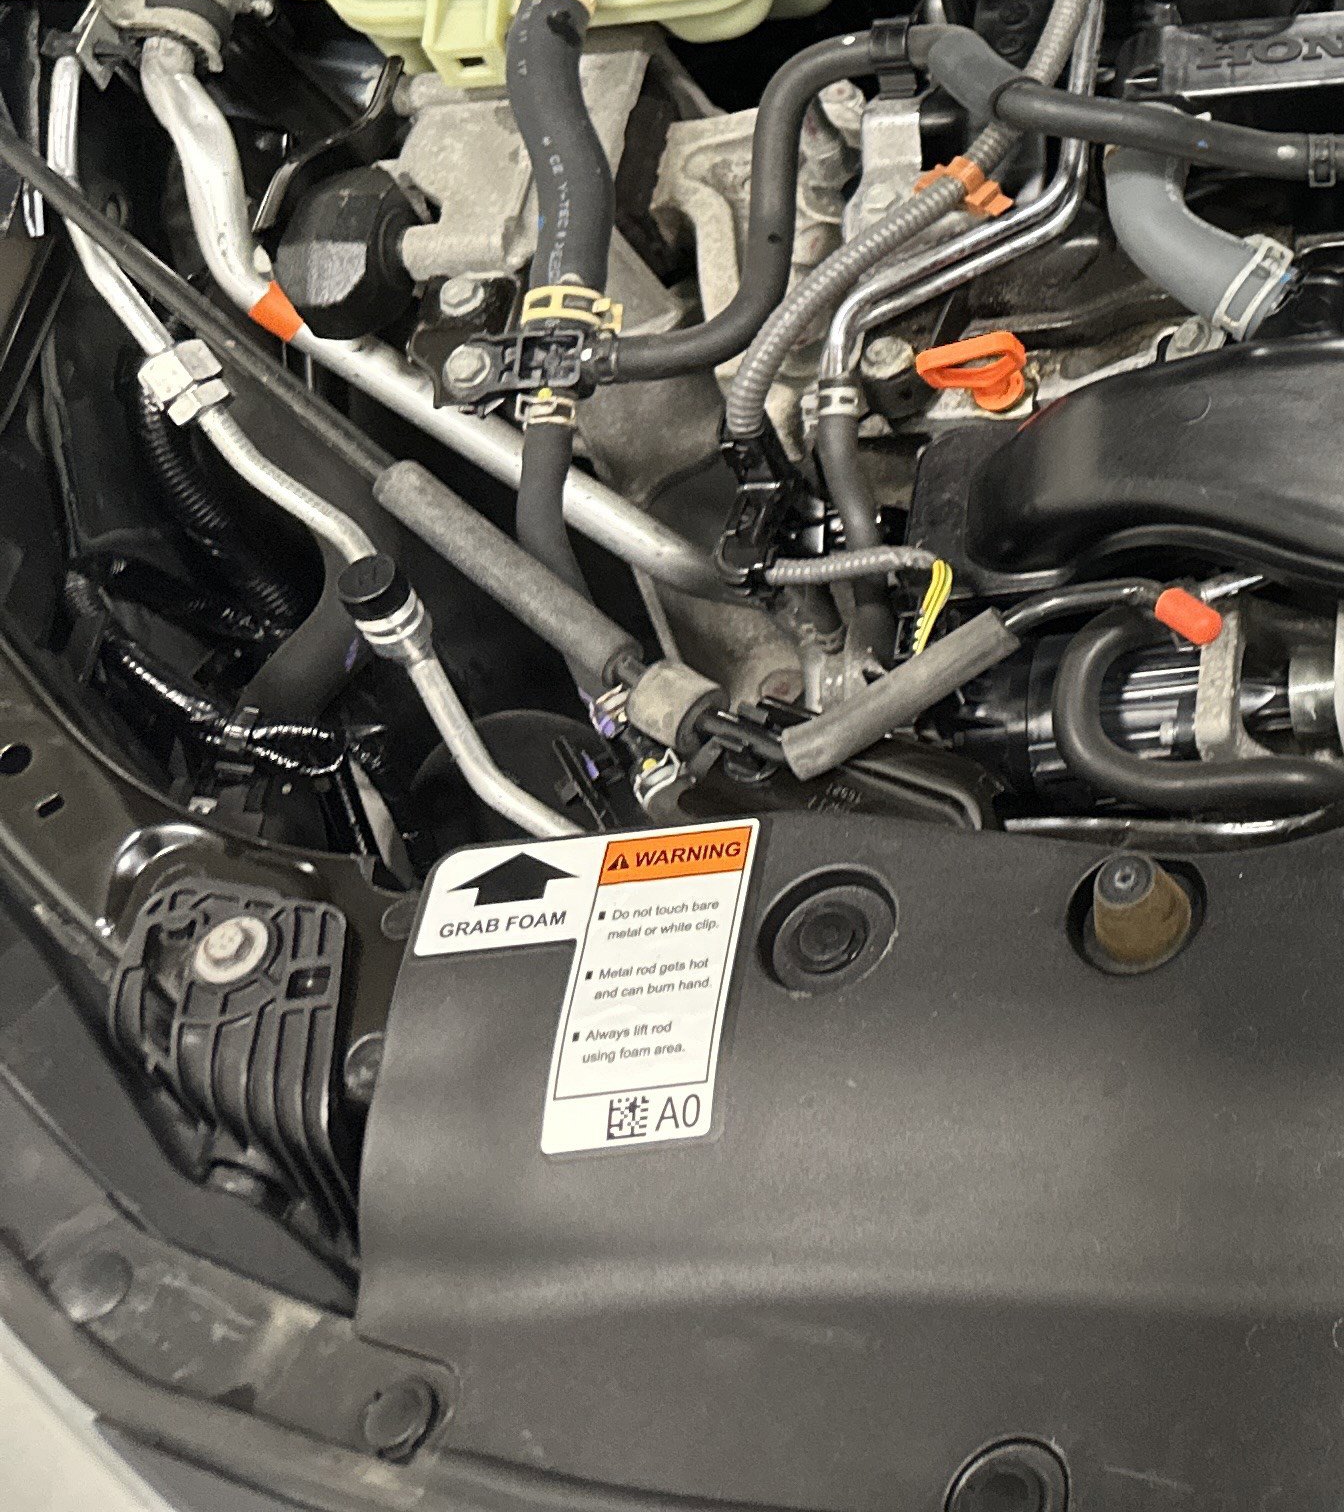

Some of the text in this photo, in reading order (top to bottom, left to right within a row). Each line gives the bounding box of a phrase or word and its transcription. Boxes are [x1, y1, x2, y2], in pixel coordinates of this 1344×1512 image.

[635, 841, 741, 868] WARNING
[612, 899, 719, 921] Do not touch bare
[439, 911, 567, 939] GRAB FOAM
[607, 918, 719, 941] metal or white clip.
[599, 957, 709, 980] Metal rod gets hot
[594, 976, 712, 1000] and can burn hand.
[586, 1020, 672, 1044] Always lift rod
[582, 1042, 686, 1064] using foam area.
[655, 1094, 701, 1132] A0
